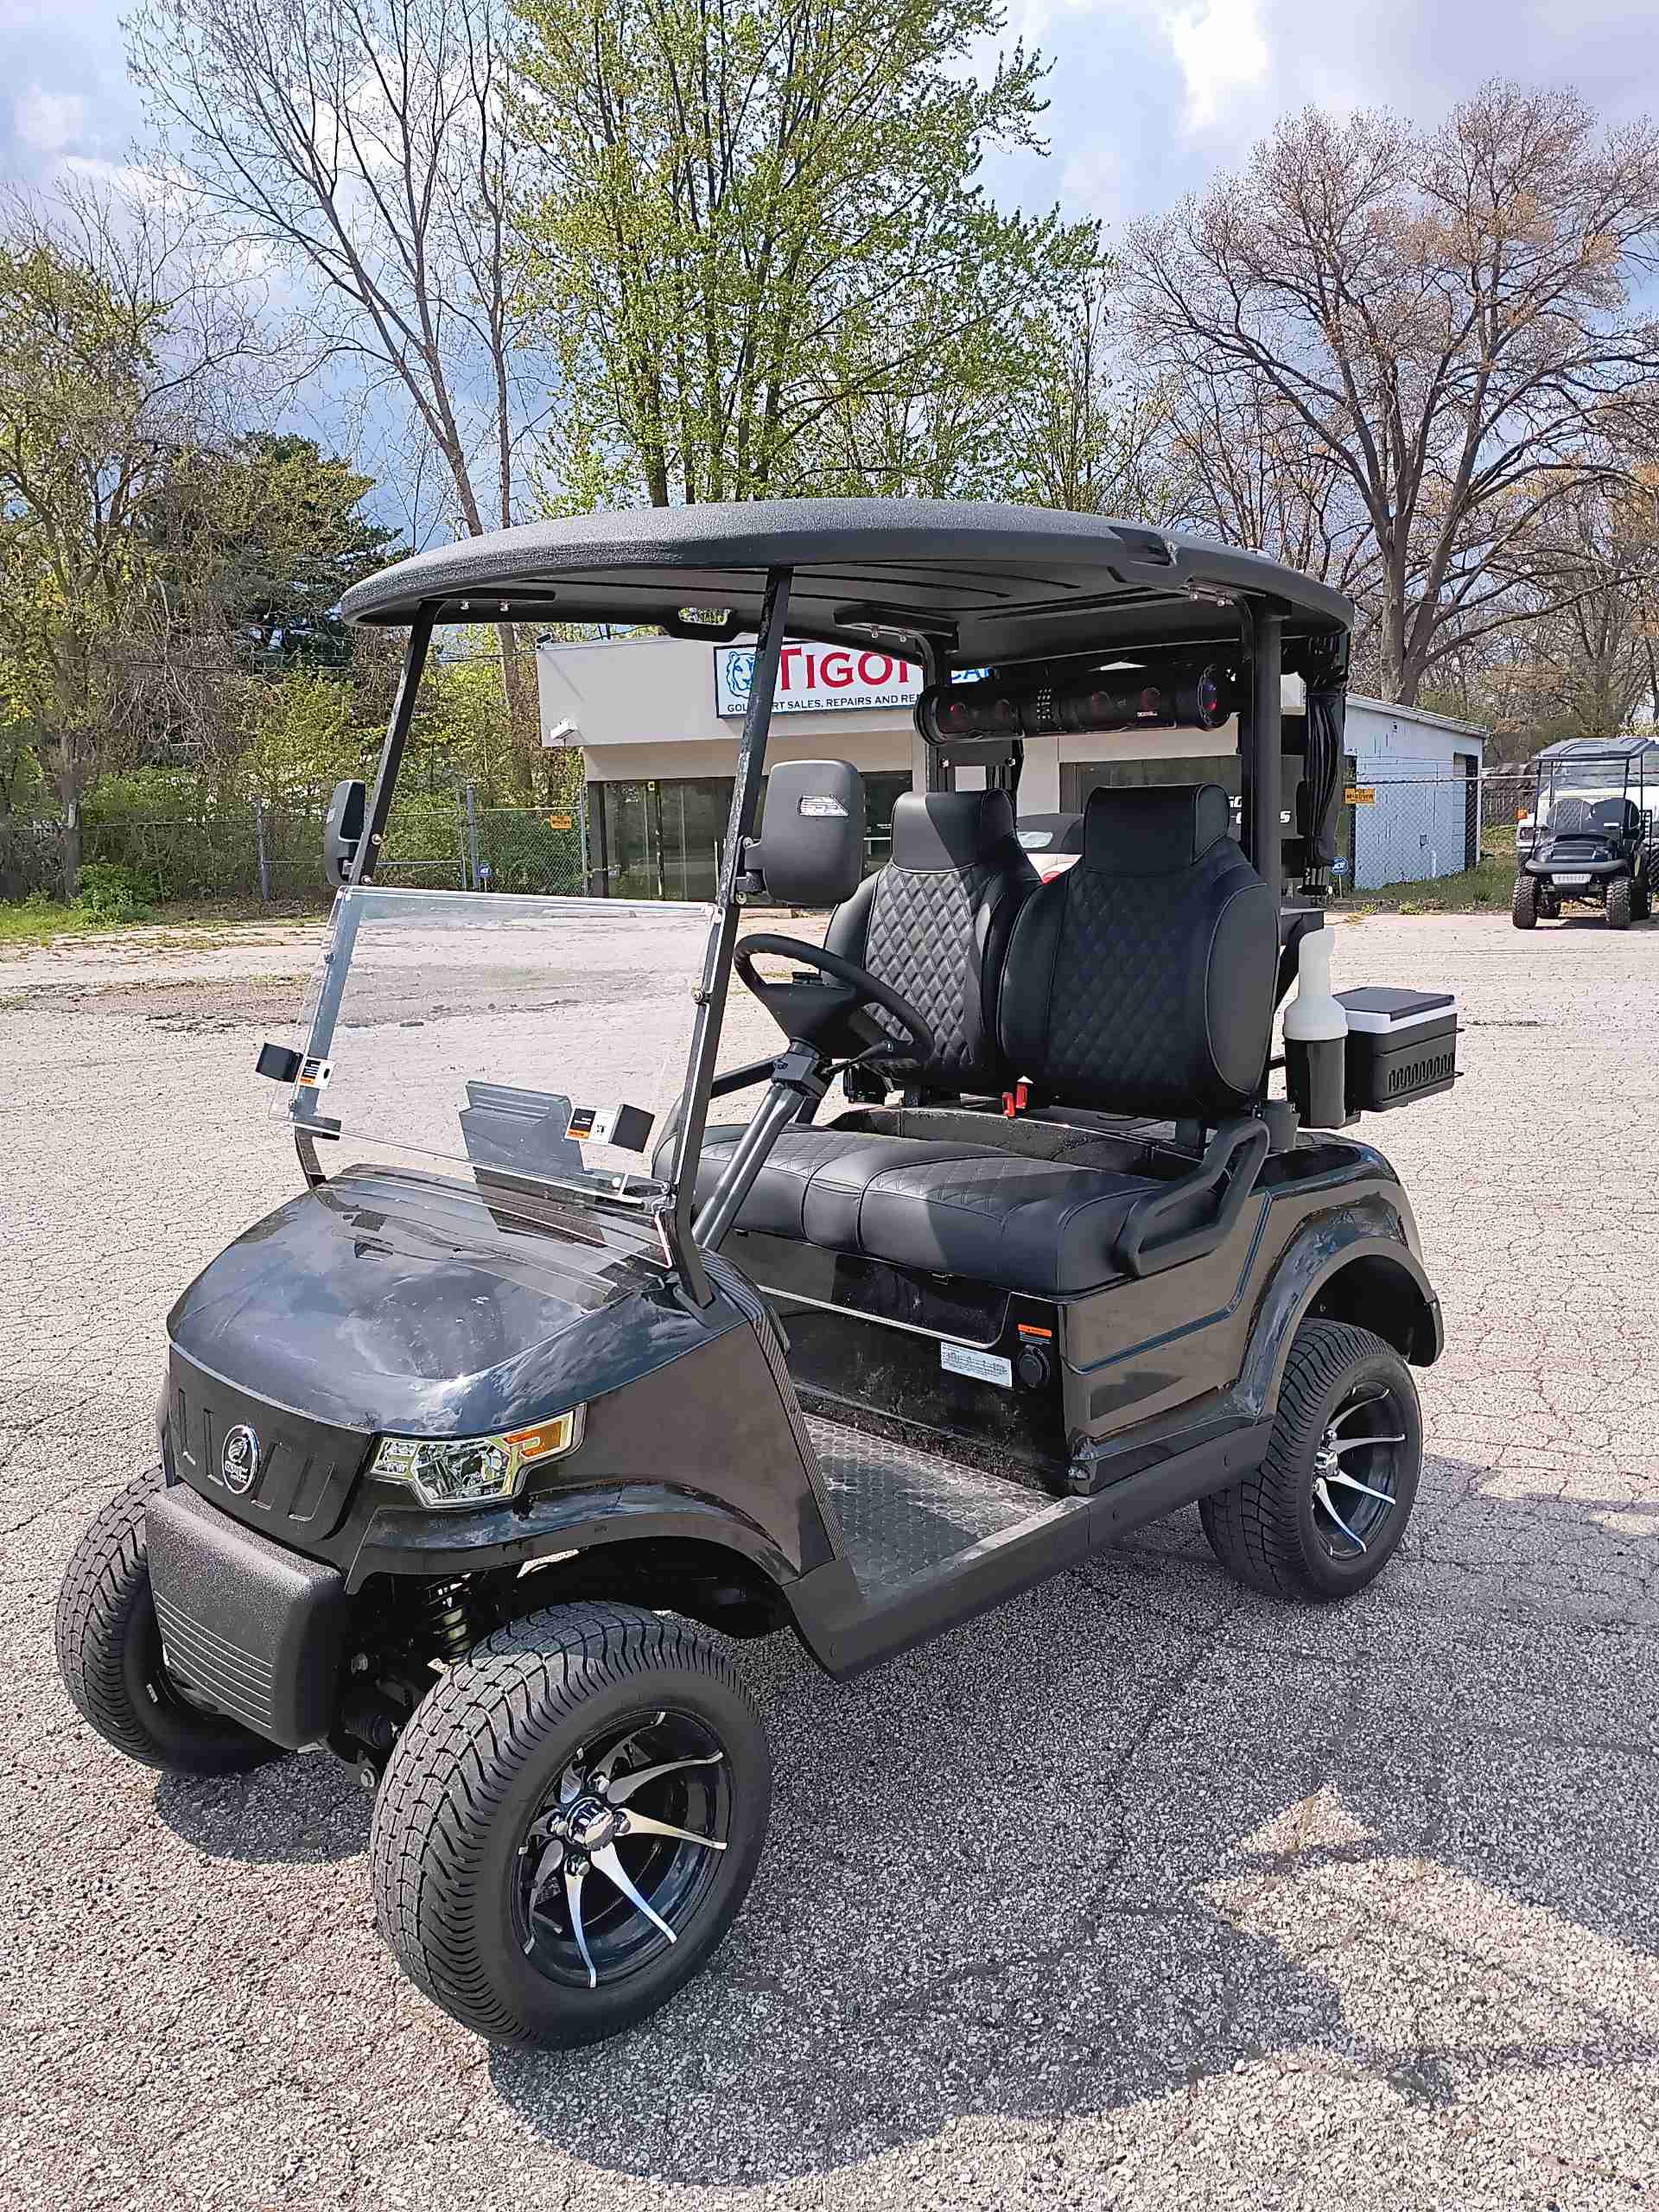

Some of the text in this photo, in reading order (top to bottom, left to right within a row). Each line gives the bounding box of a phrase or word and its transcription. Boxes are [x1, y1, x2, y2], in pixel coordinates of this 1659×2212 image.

[728, 703, 747, 712] GOL
[772, 701, 785, 709] RT
[787, 699, 823, 709] SALES,
[826, 696, 872, 707] REPAIRS
[874, 694, 899, 704] AND
